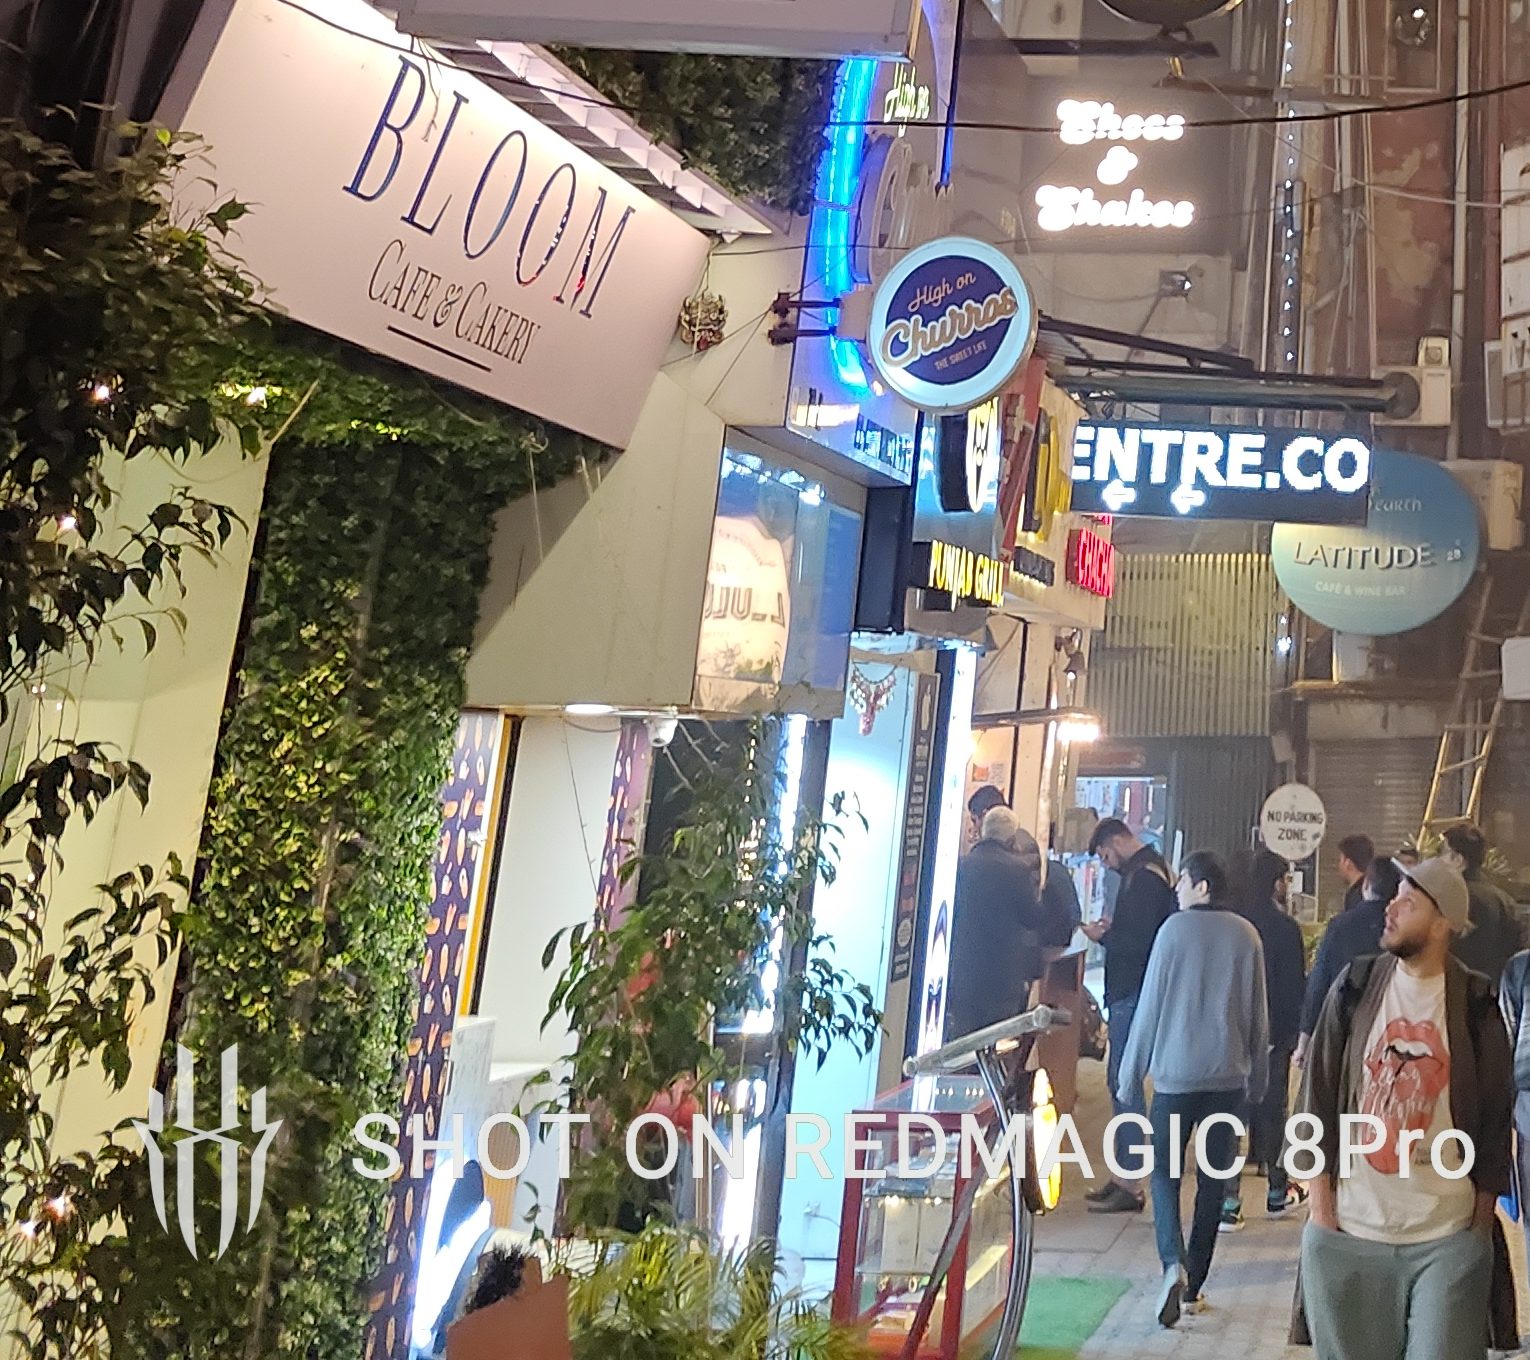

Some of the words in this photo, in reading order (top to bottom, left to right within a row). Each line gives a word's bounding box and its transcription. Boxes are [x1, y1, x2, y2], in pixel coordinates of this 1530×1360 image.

[342, 53, 637, 320] BLOOM
[432, 283, 463, 329] &
[908, 277, 954, 313] High
[956, 271, 977, 290] on
[880, 285, 1019, 369] Churros
[928, 539, 975, 612] PUNJAB
[974, 553, 1004, 607] GRILL
[1292, 541, 1438, 571] LATITUDE
[1355, 584, 1385, 596] WINE
[1387, 585, 1406, 597] BAR
[1267, 810, 1282, 823] NO
[1283, 811, 1324, 825] PARKING
[1277, 827, 1307, 841] ZONE
